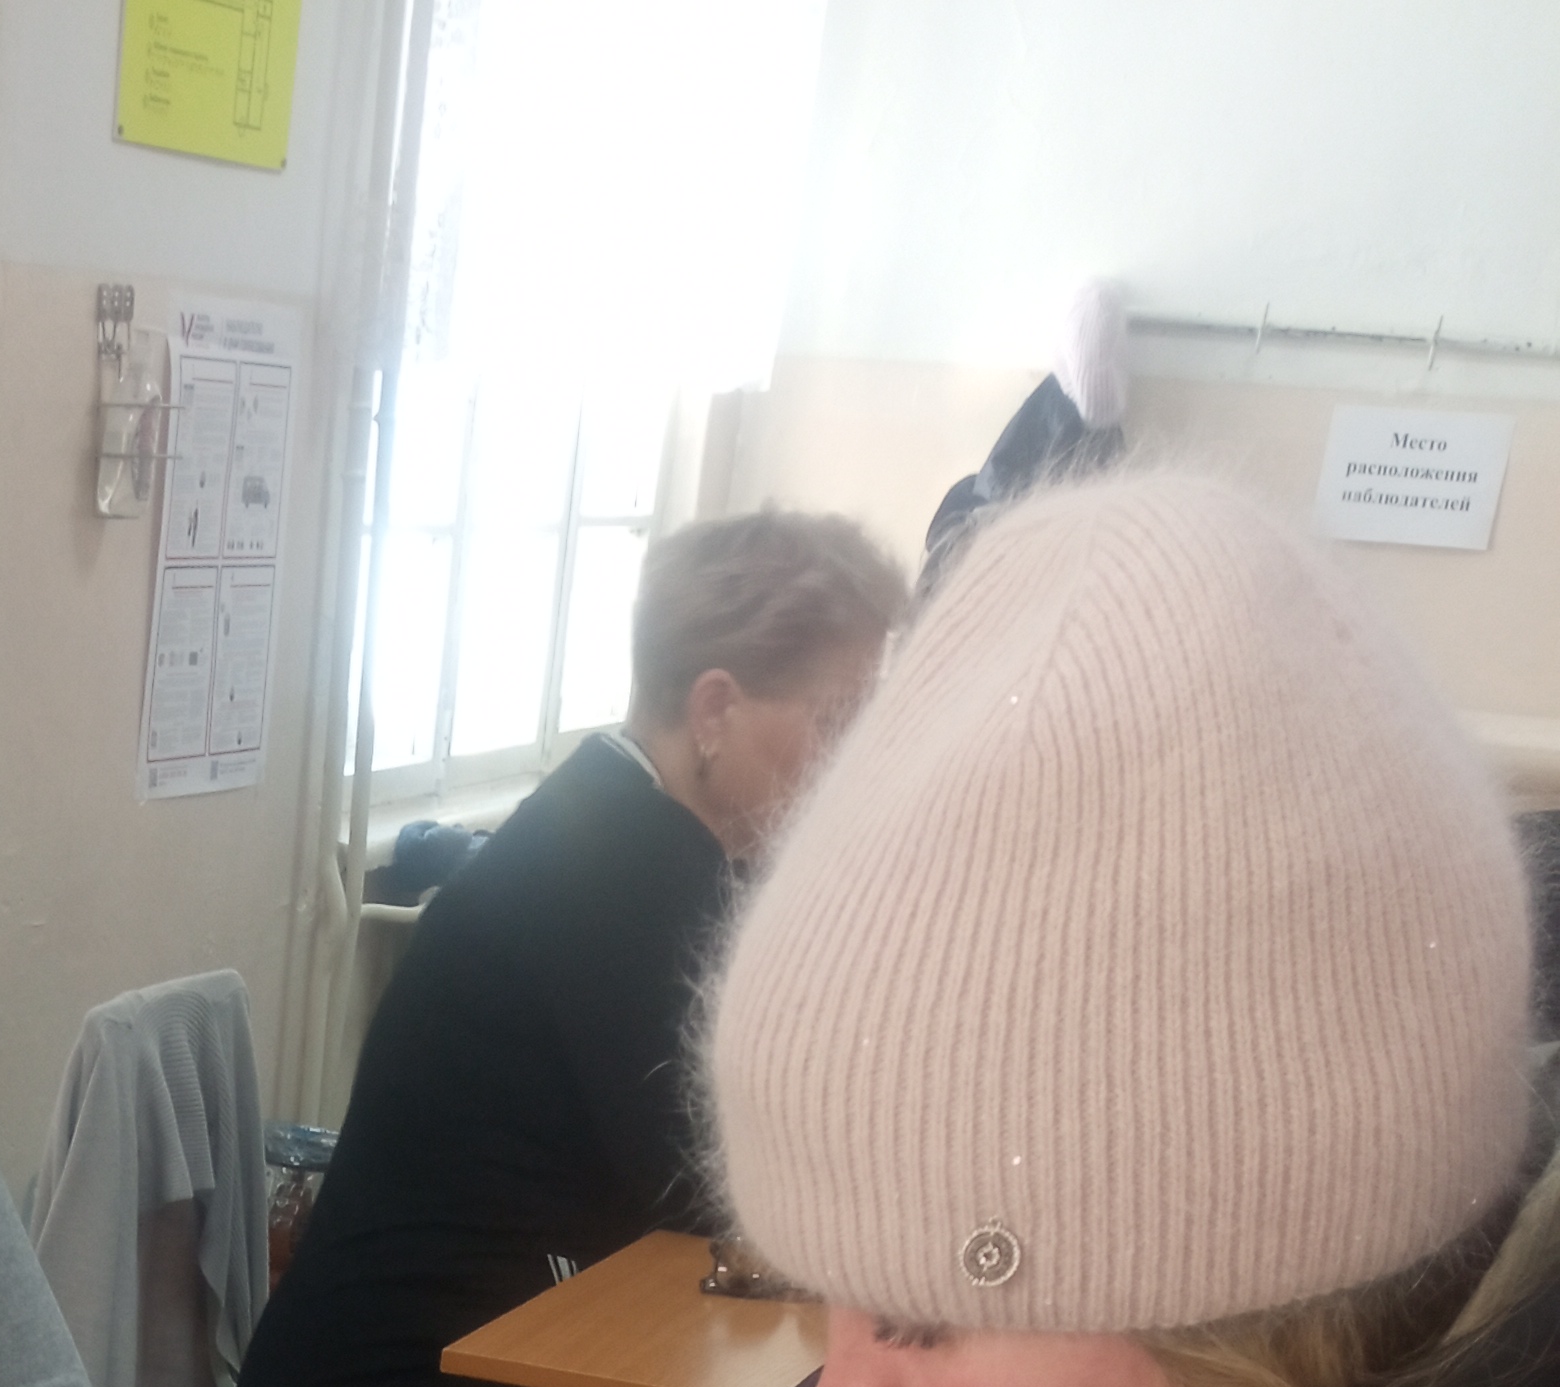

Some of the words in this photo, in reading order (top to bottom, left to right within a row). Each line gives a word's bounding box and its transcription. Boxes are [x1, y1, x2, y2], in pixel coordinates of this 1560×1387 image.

[1390, 432, 1448, 451] Место
[1345, 461, 1479, 484] расположения
[1342, 488, 1471, 513] наблюдателей
